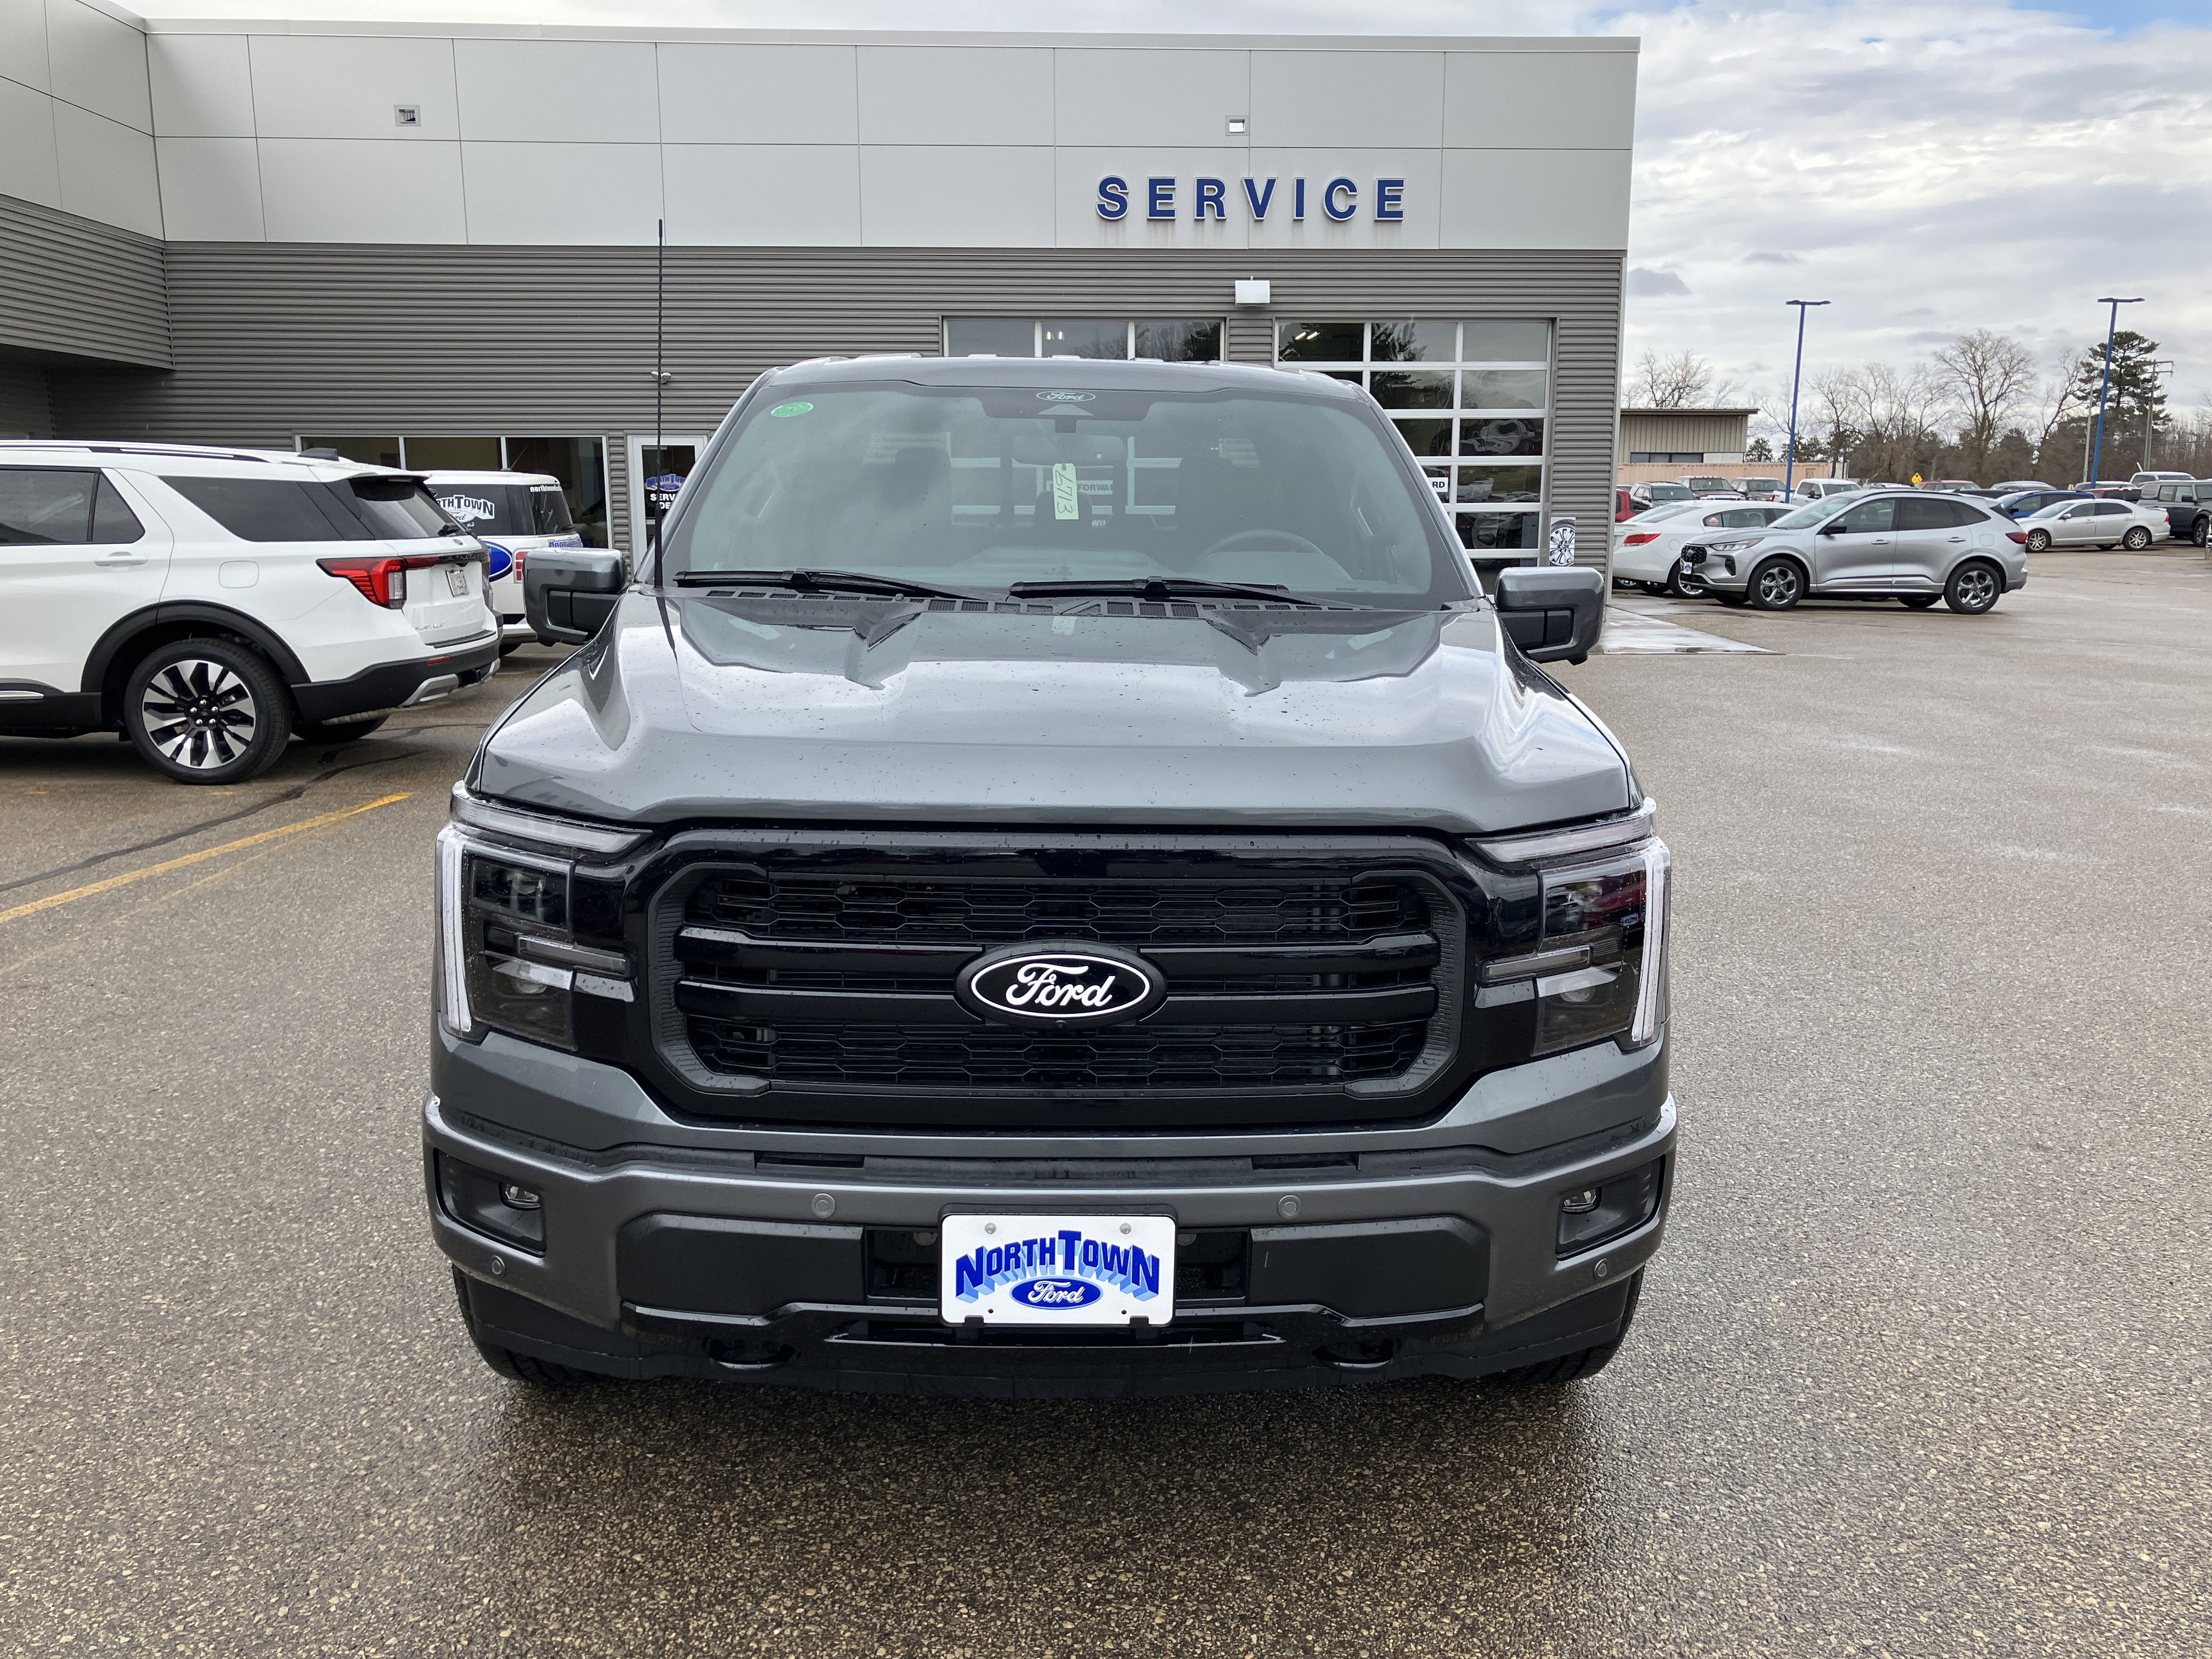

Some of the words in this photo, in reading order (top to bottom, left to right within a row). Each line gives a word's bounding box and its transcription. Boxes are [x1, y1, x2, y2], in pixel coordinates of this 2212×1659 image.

[1096, 176, 1405, 221] SERVICE
[1047, 391, 1085, 401] Ford
[1055, 470, 1074, 514] 6713
[1006, 963, 1116, 1006] Ford
[1028, 1280, 1086, 1304] Ford
